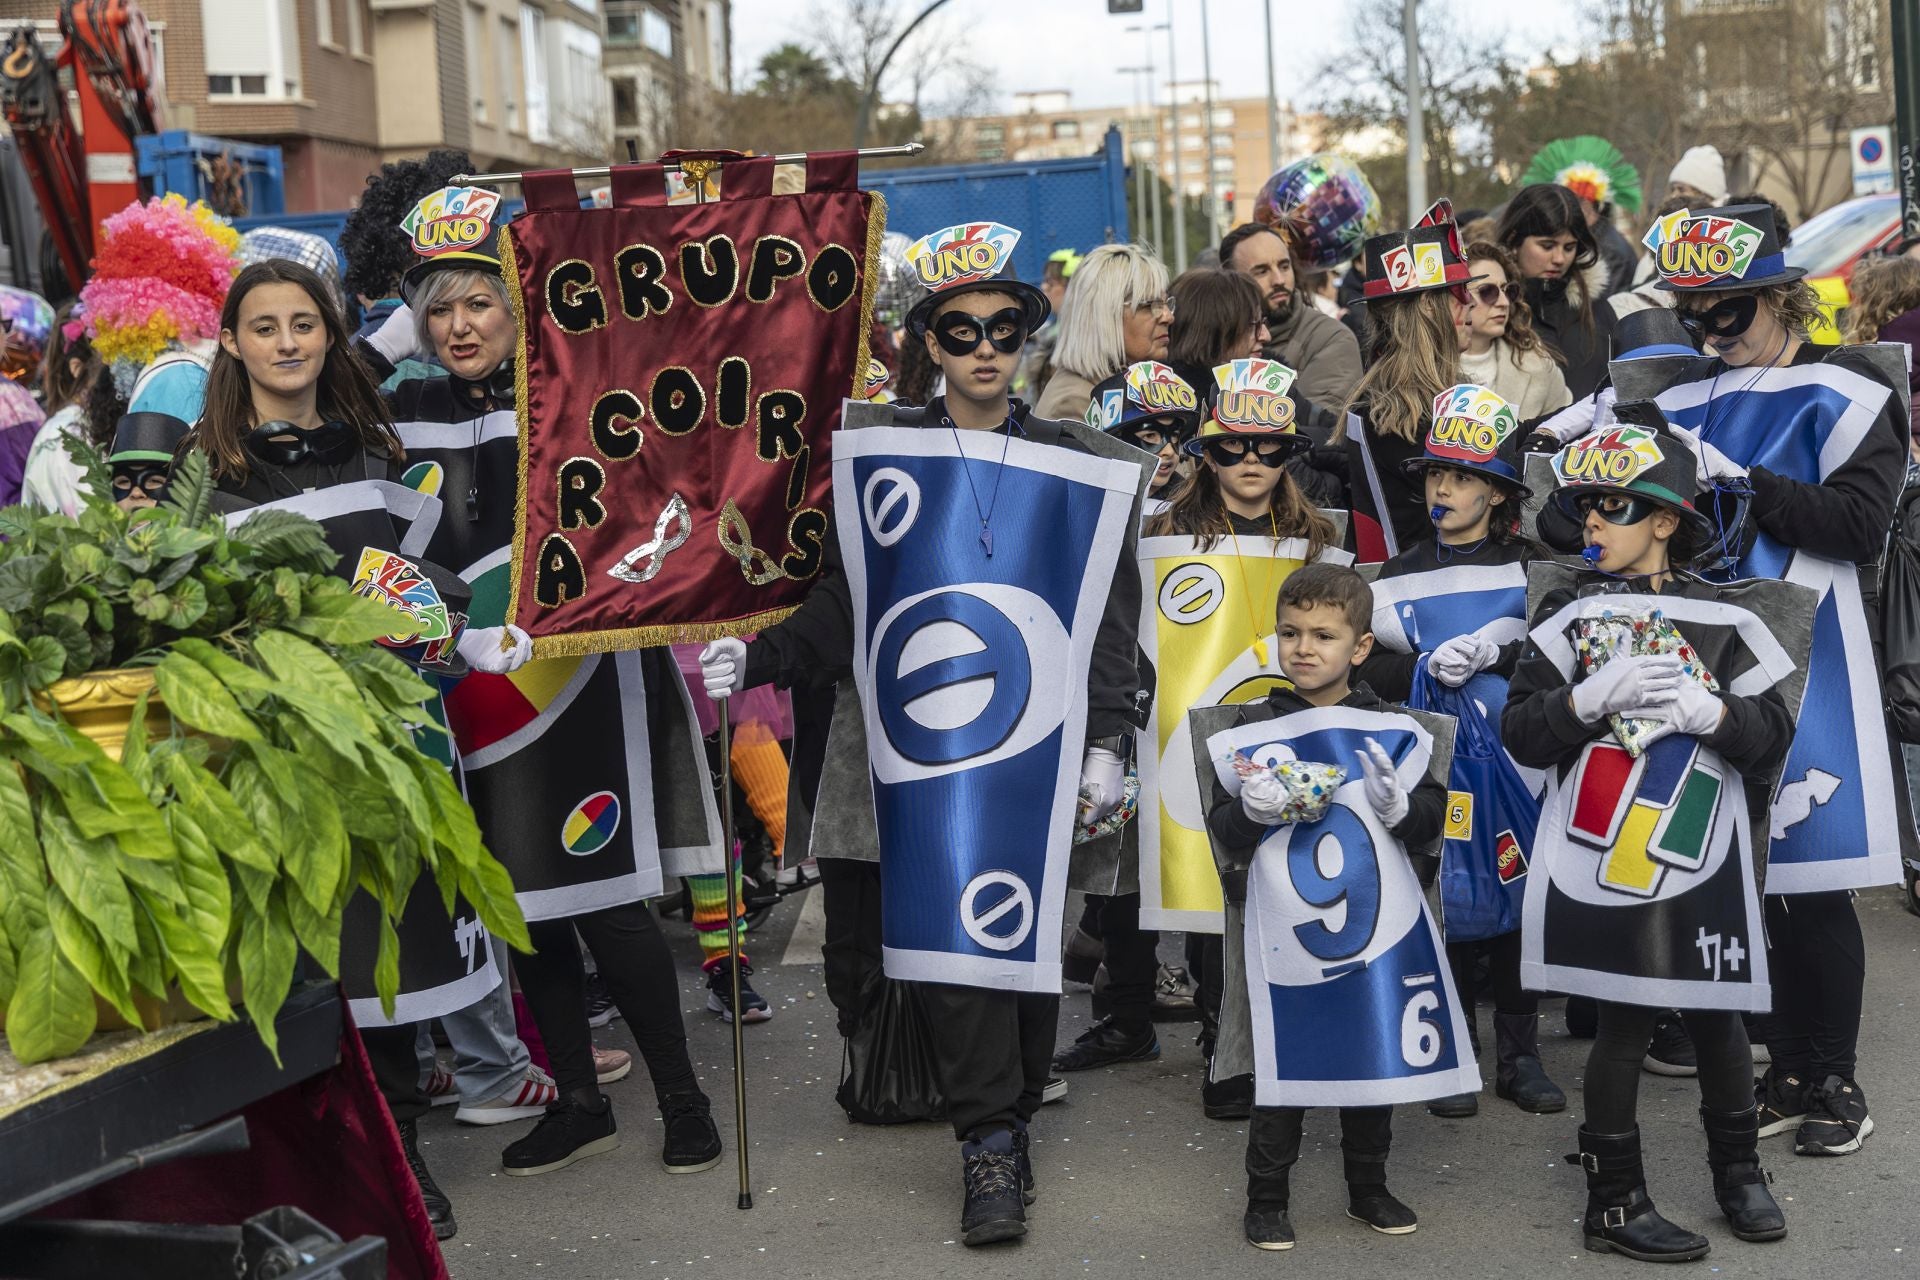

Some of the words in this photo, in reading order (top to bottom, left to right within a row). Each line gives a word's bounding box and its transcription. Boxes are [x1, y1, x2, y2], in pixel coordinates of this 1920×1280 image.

[415, 216, 484, 250] UNO
[1656, 241, 1736, 276] UNO
[1733, 239, 1748, 257] 5
[915, 241, 1000, 286] UNO
[1395, 262, 1408, 278] 2
[1424, 257, 1436, 275] 6
[545, 234, 858, 335] GRUPO
[1141, 382, 1197, 411] UNO
[1217, 391, 1294, 426] UNO
[1455, 398, 1470, 412] 2
[1108, 404, 1117, 419] 1
[1477, 404, 1491, 418] 0
[1431, 416, 1498, 453] UNO
[1560, 446, 1638, 482] UNO
[368, 567, 379, 583] 1
[1451, 806, 1464, 823] 5
[1498, 845, 1519, 869] UNO
[1287, 802, 1382, 961] 9
